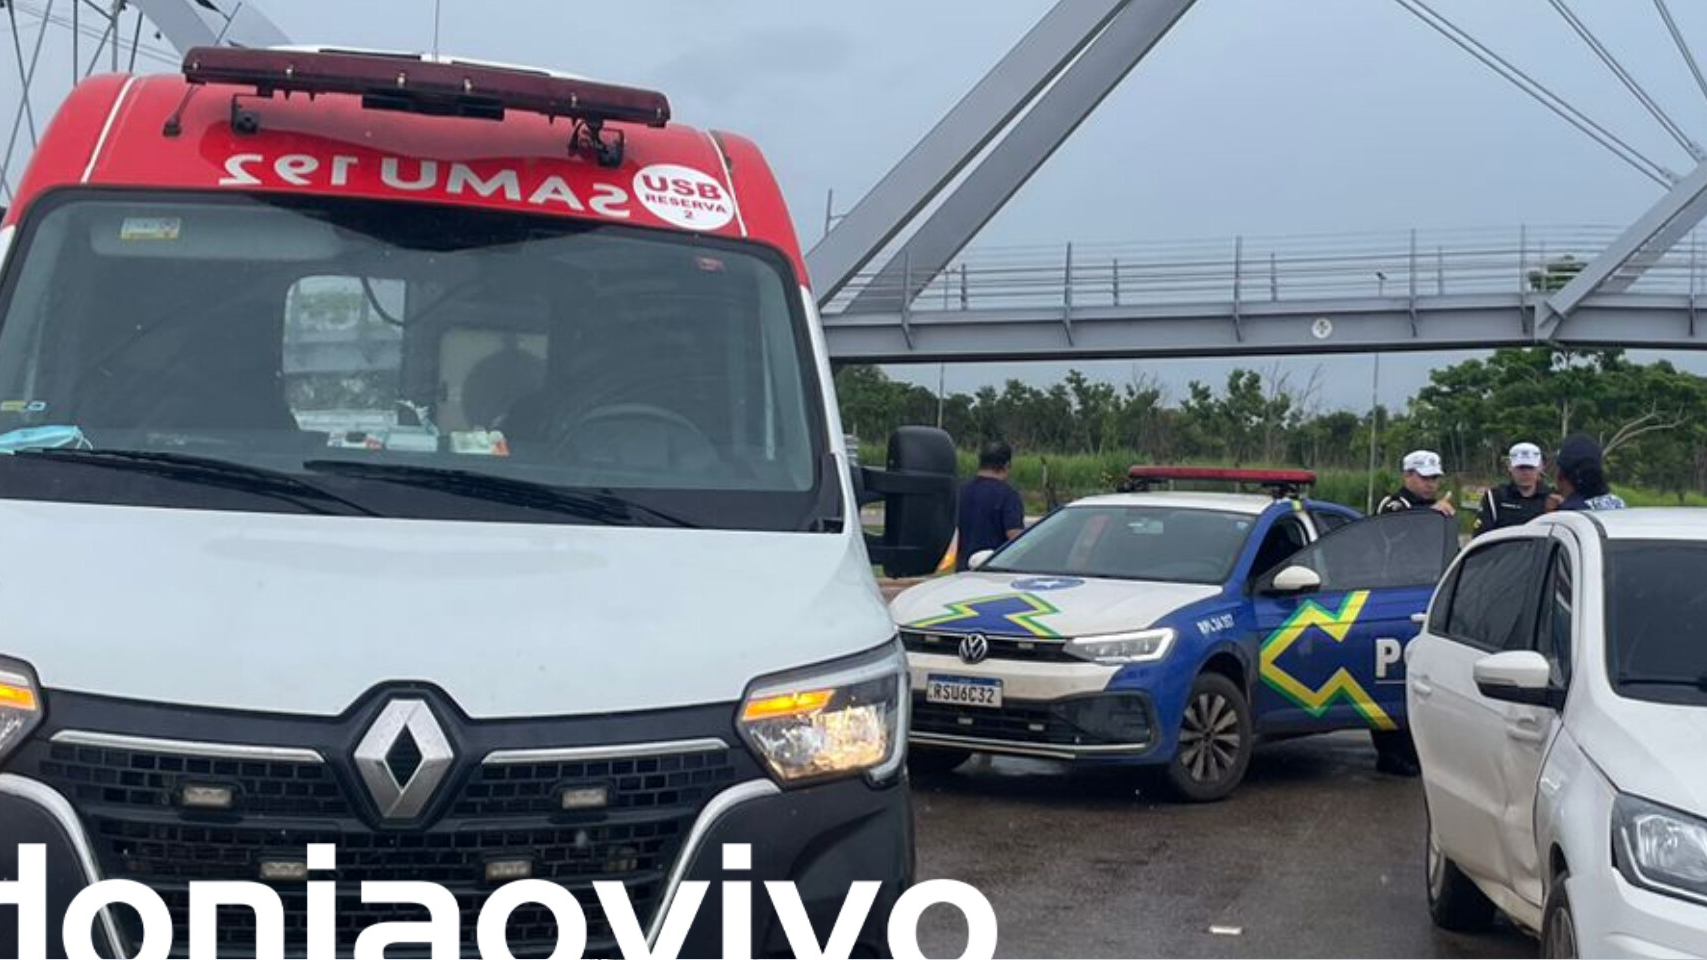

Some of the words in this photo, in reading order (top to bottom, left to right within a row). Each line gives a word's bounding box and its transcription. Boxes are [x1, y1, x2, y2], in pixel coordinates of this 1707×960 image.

[641, 174, 722, 200] USB
[644, 193, 727, 214] RESERVA
[683, 210, 694, 219] 2
[933, 682, 995, 704] RSU6C32
